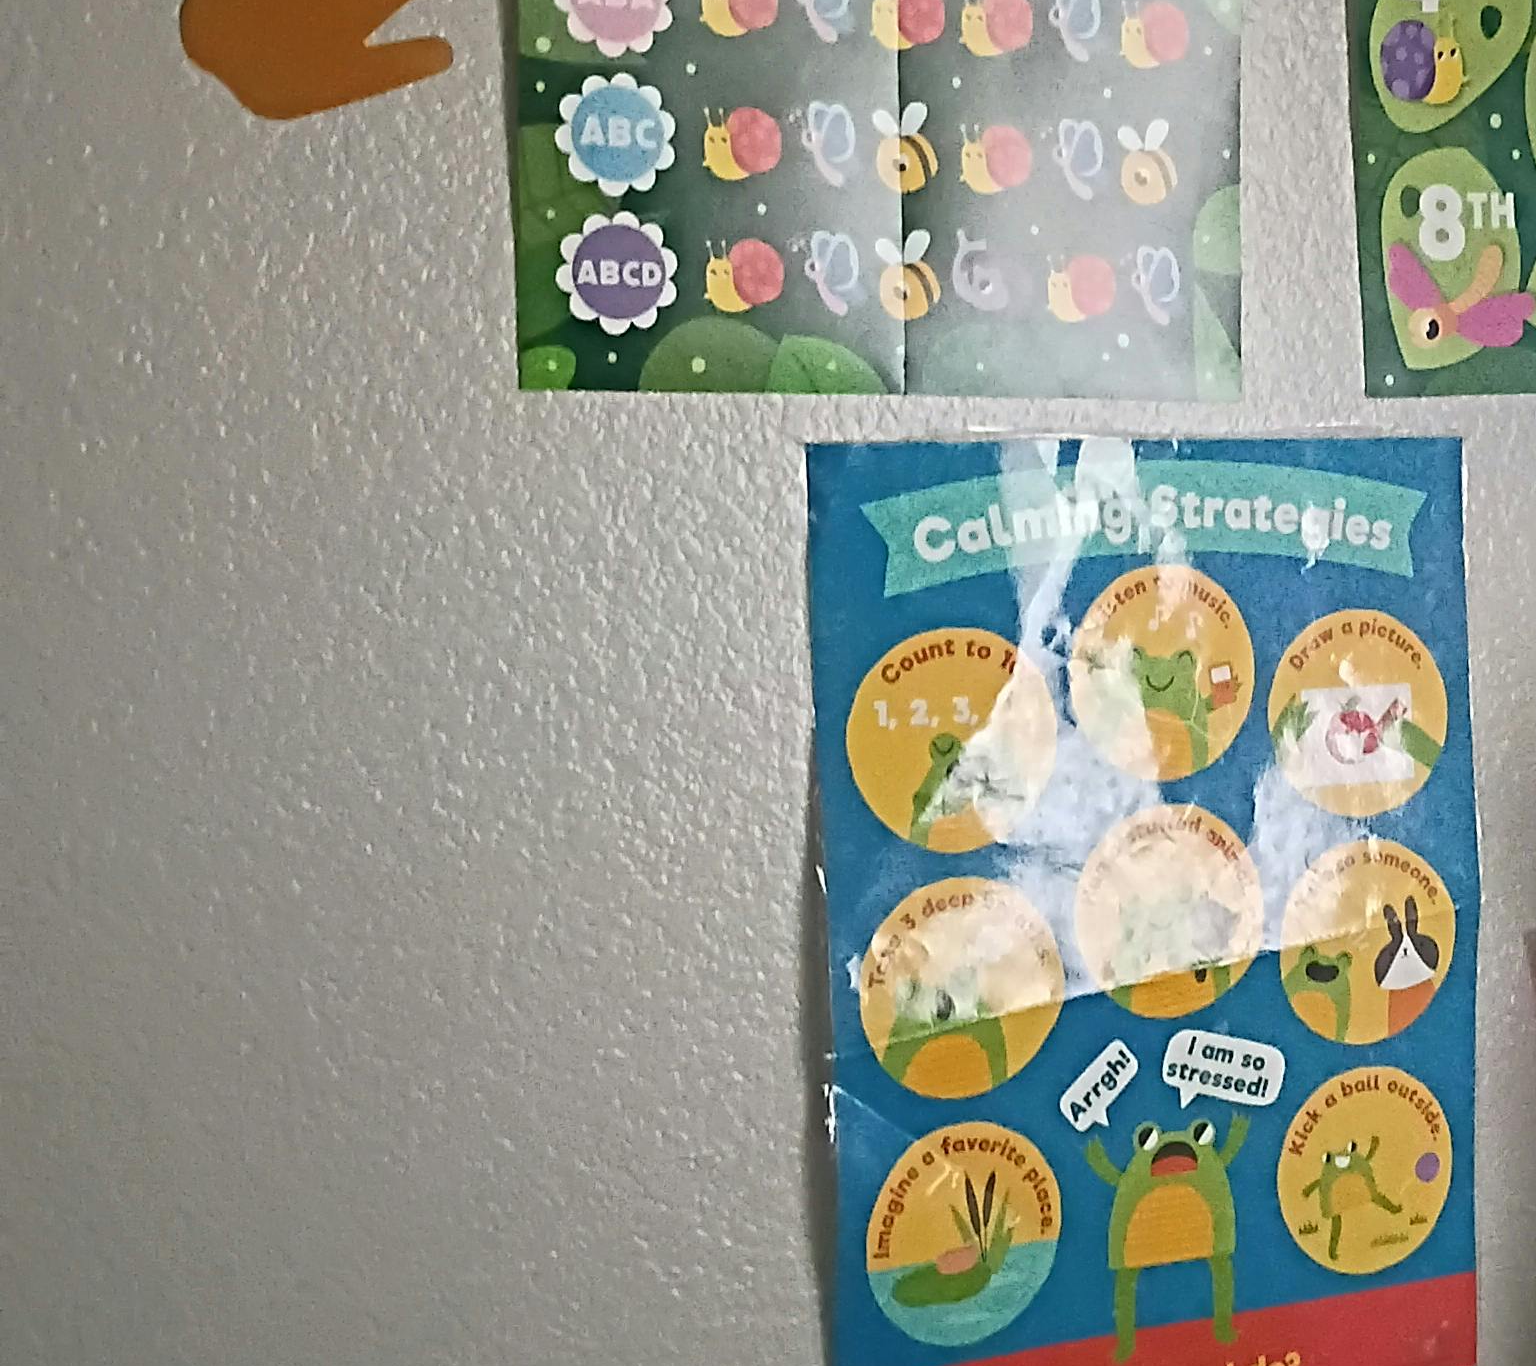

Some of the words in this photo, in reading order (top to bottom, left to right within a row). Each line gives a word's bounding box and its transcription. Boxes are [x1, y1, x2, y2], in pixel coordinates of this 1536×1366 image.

[578, 114, 658, 150] ABC
[1416, 183, 1517, 262] 8TH
[576, 258, 663, 289] ABCD
[1149, 483, 1394, 553] Strategies
[880, 638, 956, 684] Count
[966, 639, 991, 660] to
[1289, 627, 1334, 672] Draw
[1341, 620, 1353, 635] a
[1359, 615, 1423, 671] picture.
[1362, 849, 1440, 906] someone.
[1166, 1061, 1270, 1099] stressed!
[1187, 1035, 1198, 1056] I
[1201, 1043, 1235, 1065] am
[1240, 1053, 1266, 1072] so
[1068, 1048, 1132, 1124] Arrgh!
[1288, 1108, 1323, 1158] Kick
[1324, 1093, 1339, 1109] a
[1340, 1074, 1381, 1098] ball
[1386, 1079, 1442, 1143] outside.
[872, 1165, 920, 1260] Imagine
[921, 1150, 936, 1166] a
[940, 1134, 1028, 1168] favorite
[1021, 1166, 1054, 1236] place.
